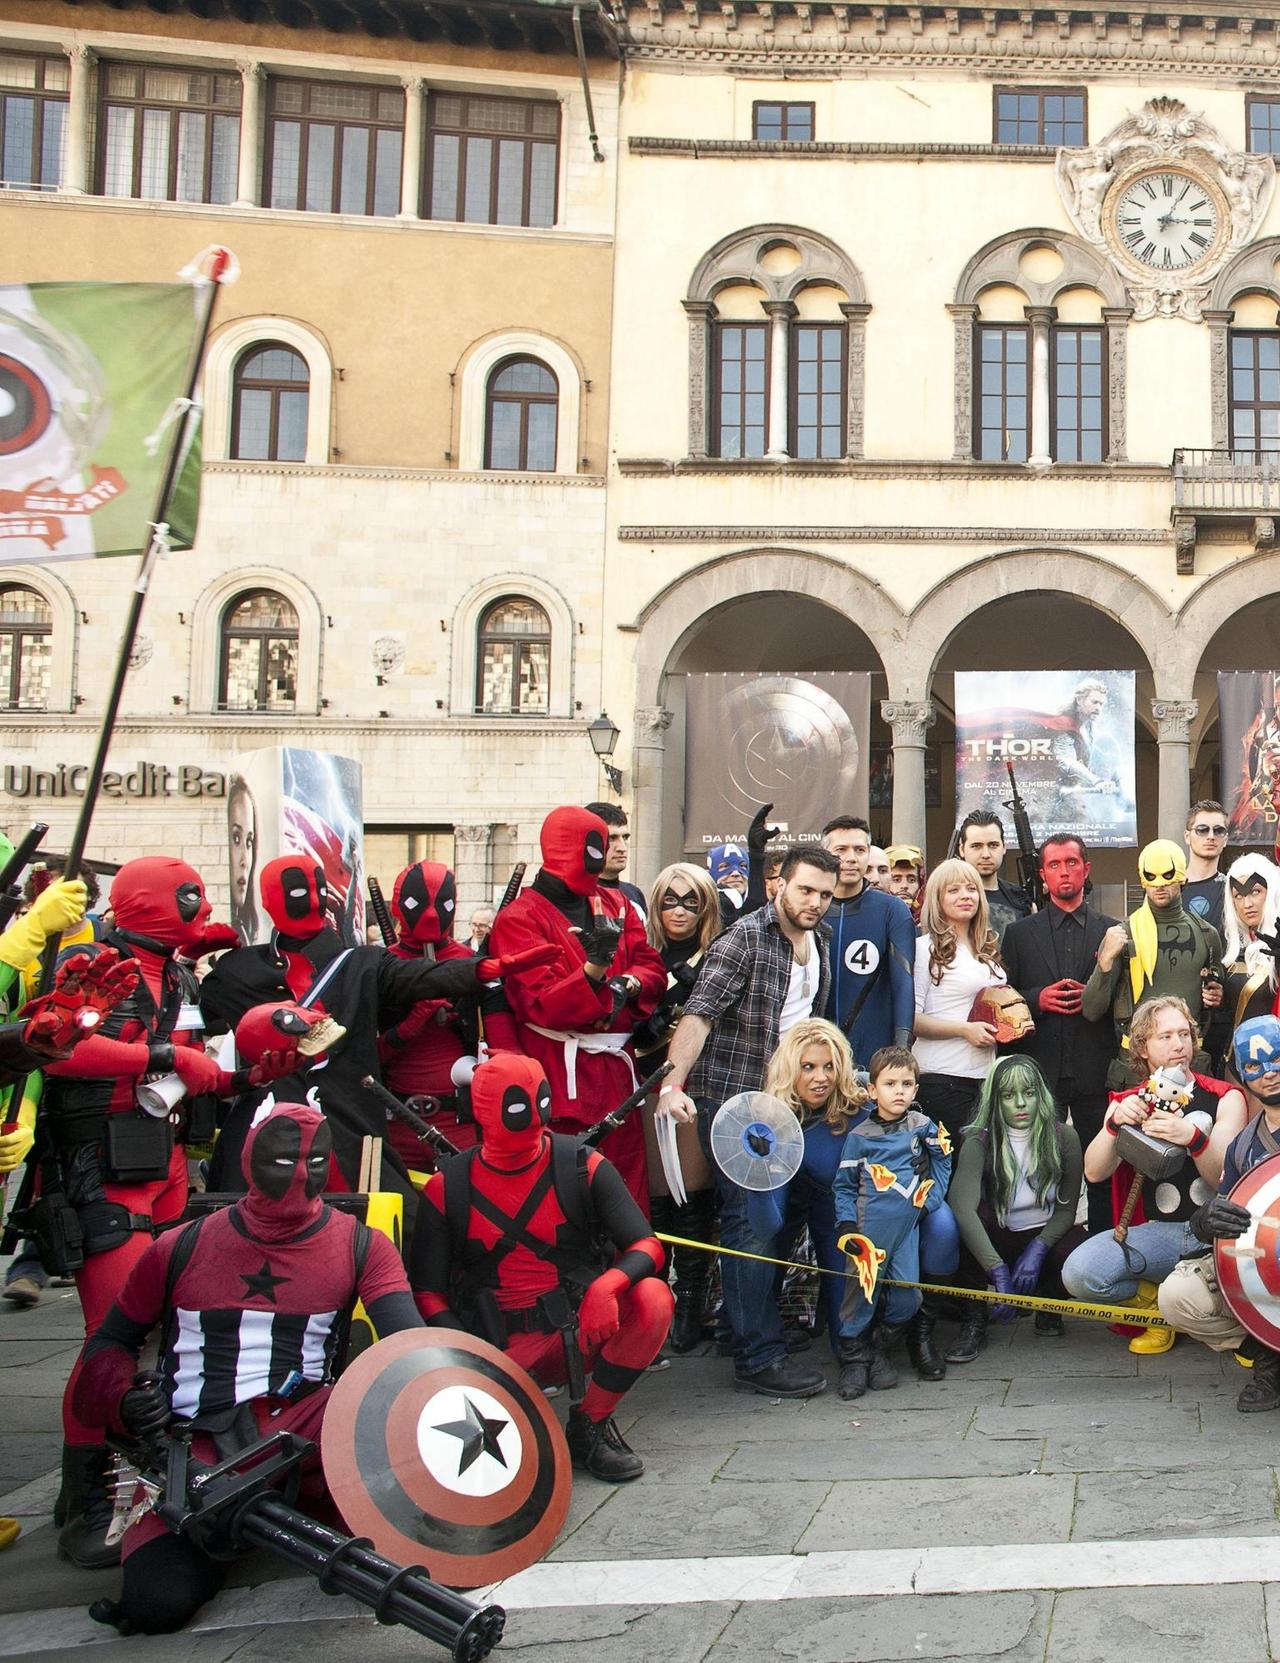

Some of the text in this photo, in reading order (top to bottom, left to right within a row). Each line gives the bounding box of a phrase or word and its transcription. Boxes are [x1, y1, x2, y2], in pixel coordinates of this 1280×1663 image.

[964, 739, 1053, 756] THOR
[4, 761, 227, 798] UniCedit Ba
[964, 781, 983, 789] DAL
[1001, 780, 1058, 788] NVEMBRE
[702, 834, 723, 843] DA
[779, 834, 796, 842] AL
[798, 833, 822, 842] CIN
[850, 942, 870, 970] 4
[1041, 1302, 1076, 1315] CROSS
[1077, 1307, 1097, 1318] NOT
[1097, 1310, 1113, 1319] DO
[1122, 1312, 1149, 1325] AREA
